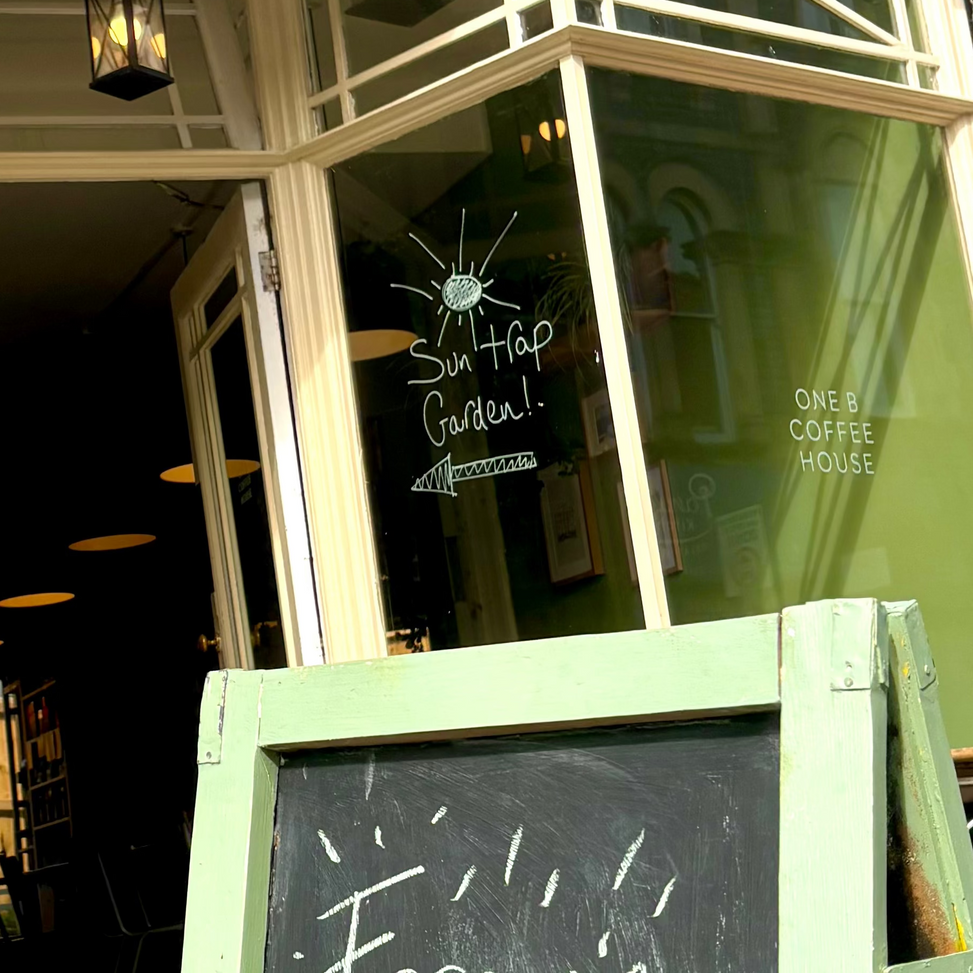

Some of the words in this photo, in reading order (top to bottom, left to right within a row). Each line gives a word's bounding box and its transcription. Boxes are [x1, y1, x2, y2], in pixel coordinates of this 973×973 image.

[407, 338, 473, 385] Sun
[794, 388, 840, 412] ONE
[846, 391, 859, 413] B
[789, 418, 875, 444] COFFEE
[799, 450, 875, 475] HOUSE
